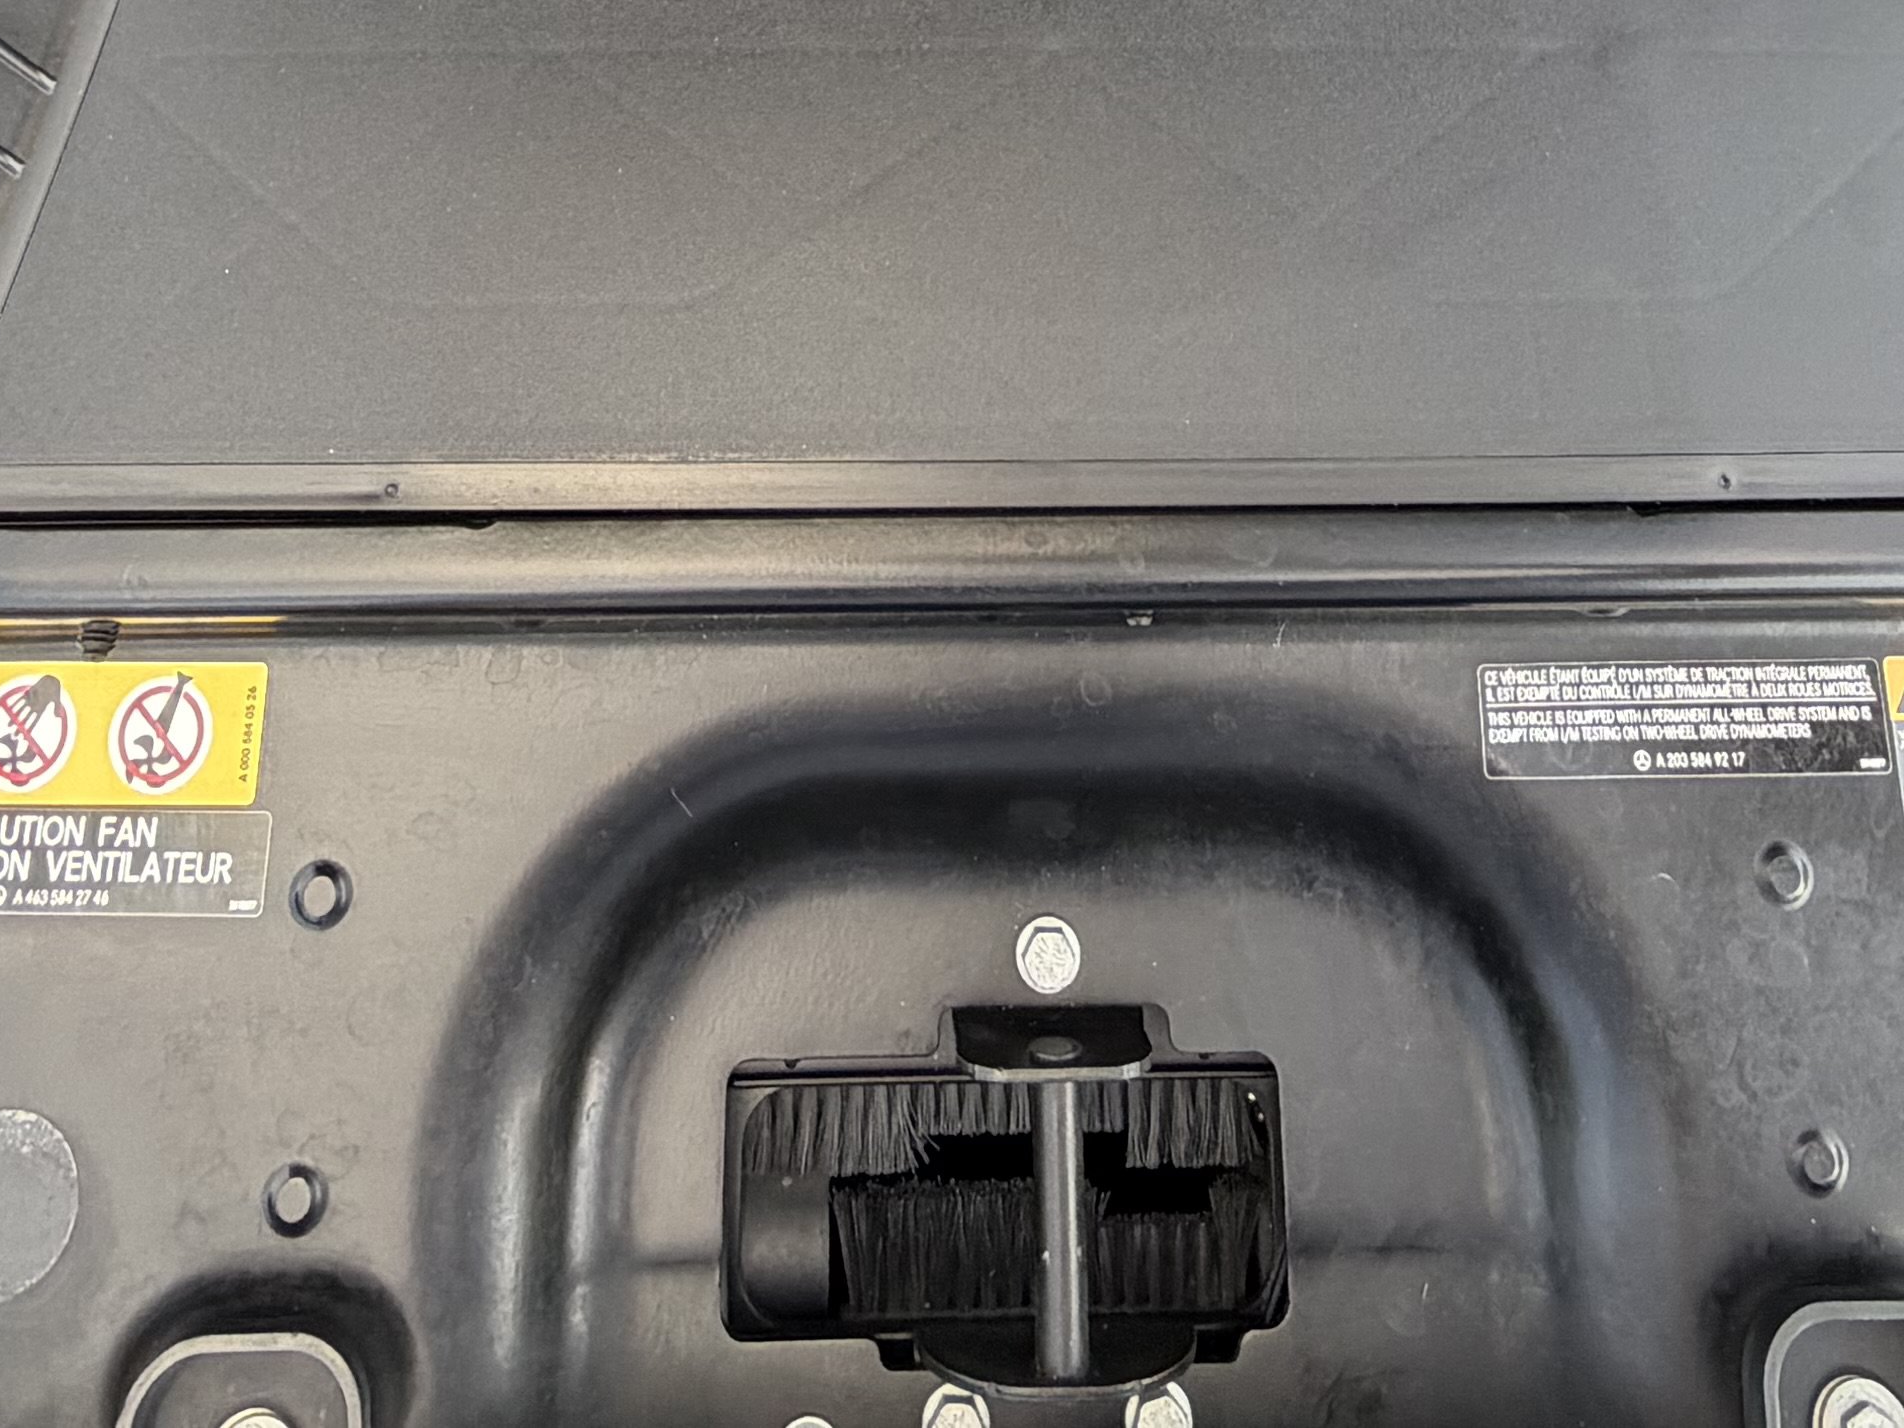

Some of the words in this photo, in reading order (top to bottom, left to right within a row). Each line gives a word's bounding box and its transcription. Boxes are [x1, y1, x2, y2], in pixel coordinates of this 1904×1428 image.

[1691, 668, 1704, 682] DE
[1562, 685, 1577, 699] DU
[1654, 685, 1673, 699] SUR
[1487, 711, 1511, 727] THIS
[1513, 711, 1552, 726] VEHICLE
[1555, 710, 1565, 725] IS
[1617, 709, 1642, 724] WITH
[1643, 709, 1651, 723] A
[1767, 707, 1796, 721] DRIVE
[1798, 706, 1837, 721] SYSTEM
[1838, 706, 1859, 721] AND
[1861, 706, 1872, 721] IS
[1529, 728, 1558, 743] FROM
[1581, 727, 1621, 742] TESTING
[1622, 726, 1639, 741] ON
[1699, 725, 1728, 740] DRIVE
[1656, 754, 1666, 768] A
[239, 773, 248, 783] A
[97, 815, 159, 848] FAN
[47, 851, 234, 885] VENTILATEUR
[12, 890, 24, 906] A
[25, 890, 49, 906] 463
[75, 890, 92, 906] 27
